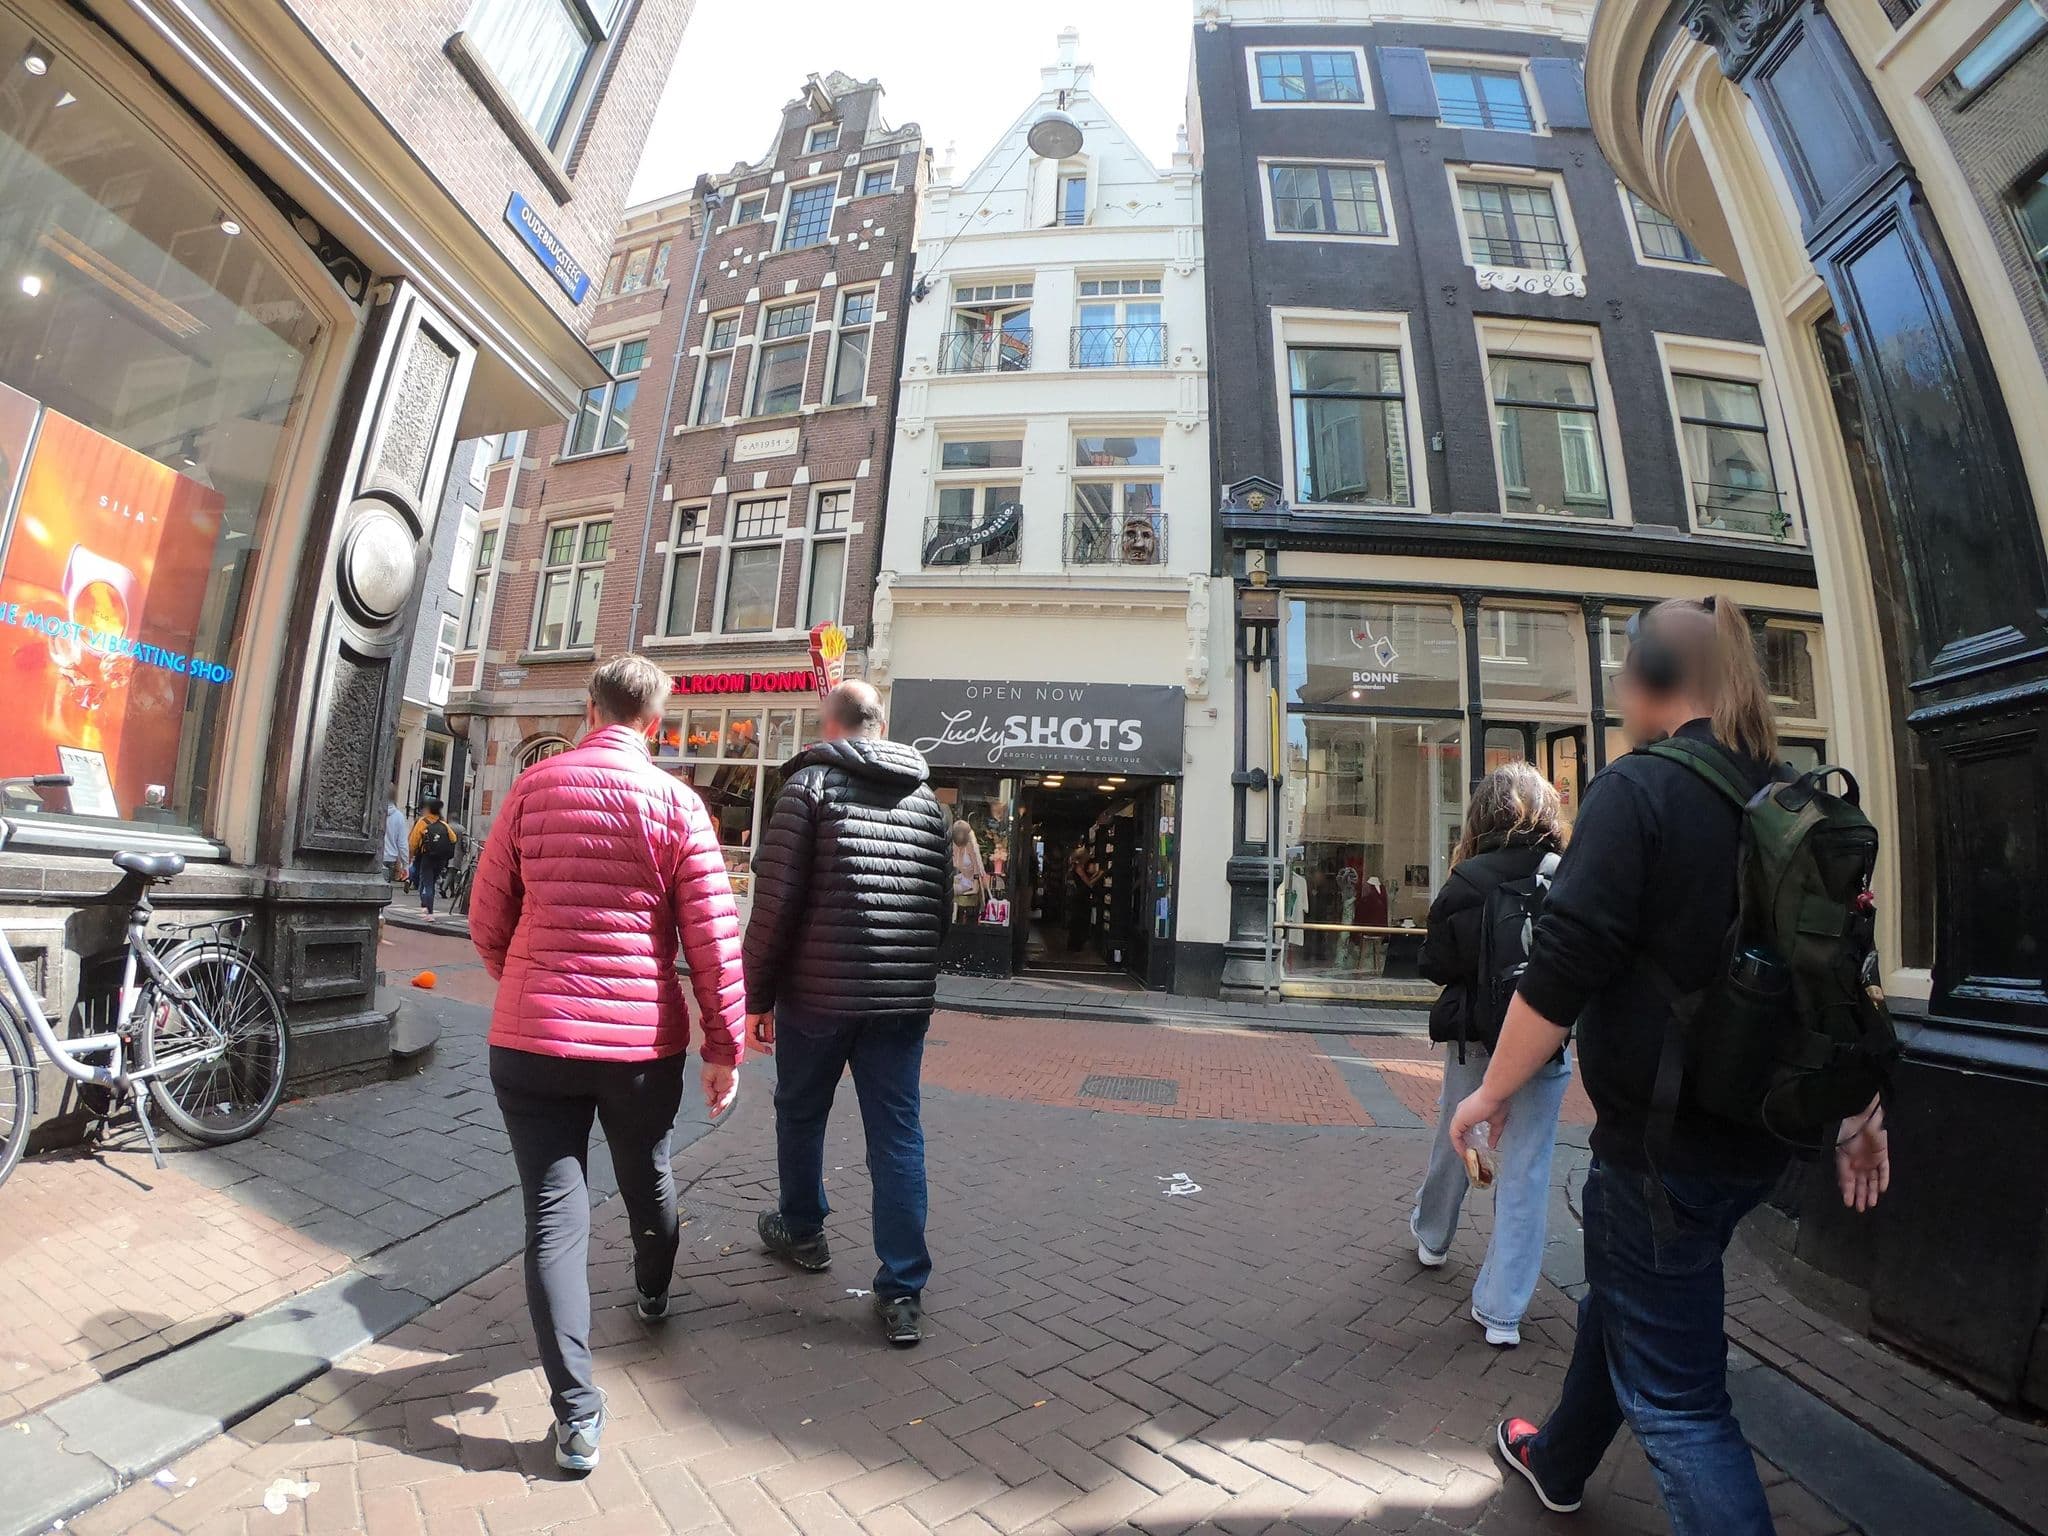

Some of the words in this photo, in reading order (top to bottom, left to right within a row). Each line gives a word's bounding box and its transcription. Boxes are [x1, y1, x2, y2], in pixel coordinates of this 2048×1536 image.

[521, 206, 581, 283] OUDEBRUGSTEEG
[554, 264, 577, 294] CENTRUM
[23, 610, 83, 640] MOST
[88, 629, 186, 672] VIBRATING
[189, 658, 233, 685] SHOP
[815, 665, 829, 700] DON
[1352, 671, 1399, 683] BONNE
[966, 686, 1023, 701] OPEN
[1036, 688, 1085, 702] NOW
[912, 710, 1006, 763] Lucky
[1004, 715, 1143, 751] SHOTS
[1095, 756, 1140, 764] BOUTIQUE
